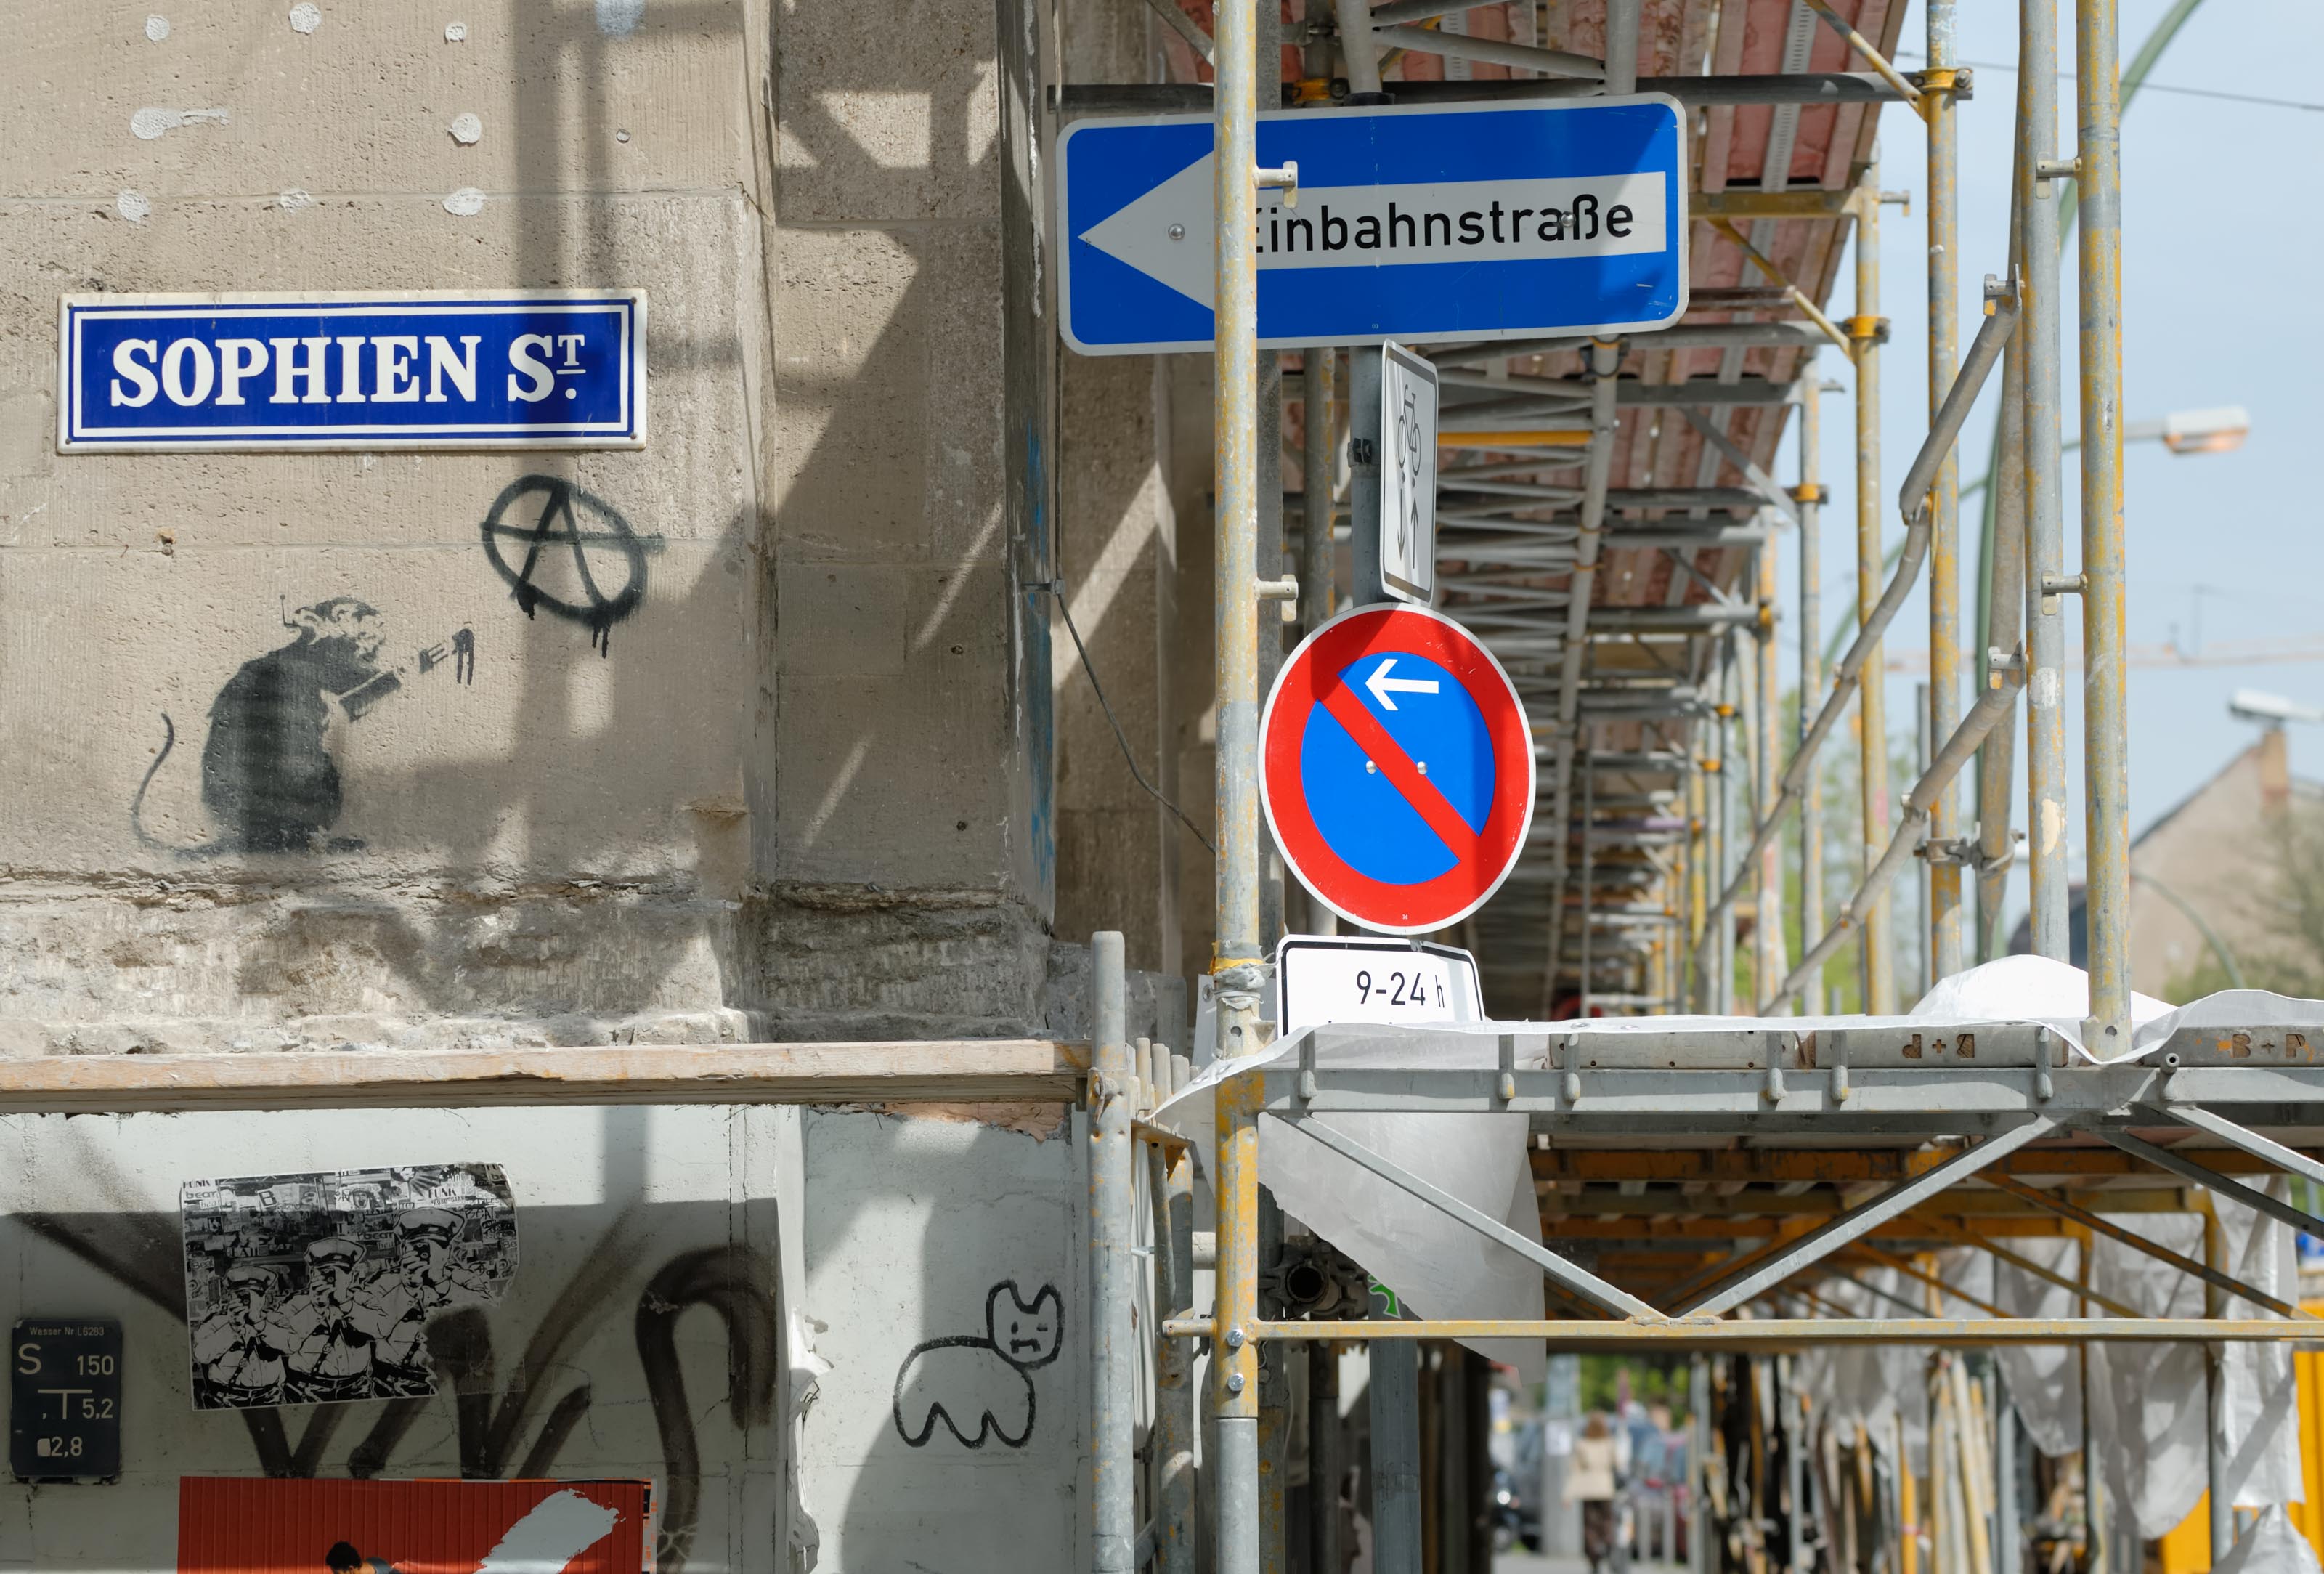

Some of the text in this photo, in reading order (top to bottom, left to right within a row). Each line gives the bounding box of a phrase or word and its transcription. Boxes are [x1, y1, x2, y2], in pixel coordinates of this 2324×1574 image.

[110, 335, 482, 407] SOPHIEN
[1356, 970, 1445, 1008] 9-24 h
[29, 1327, 62, 1336] Wasser
[18, 1343, 114, 1376] S 150
[82, 1397, 114, 1419] 5,2
